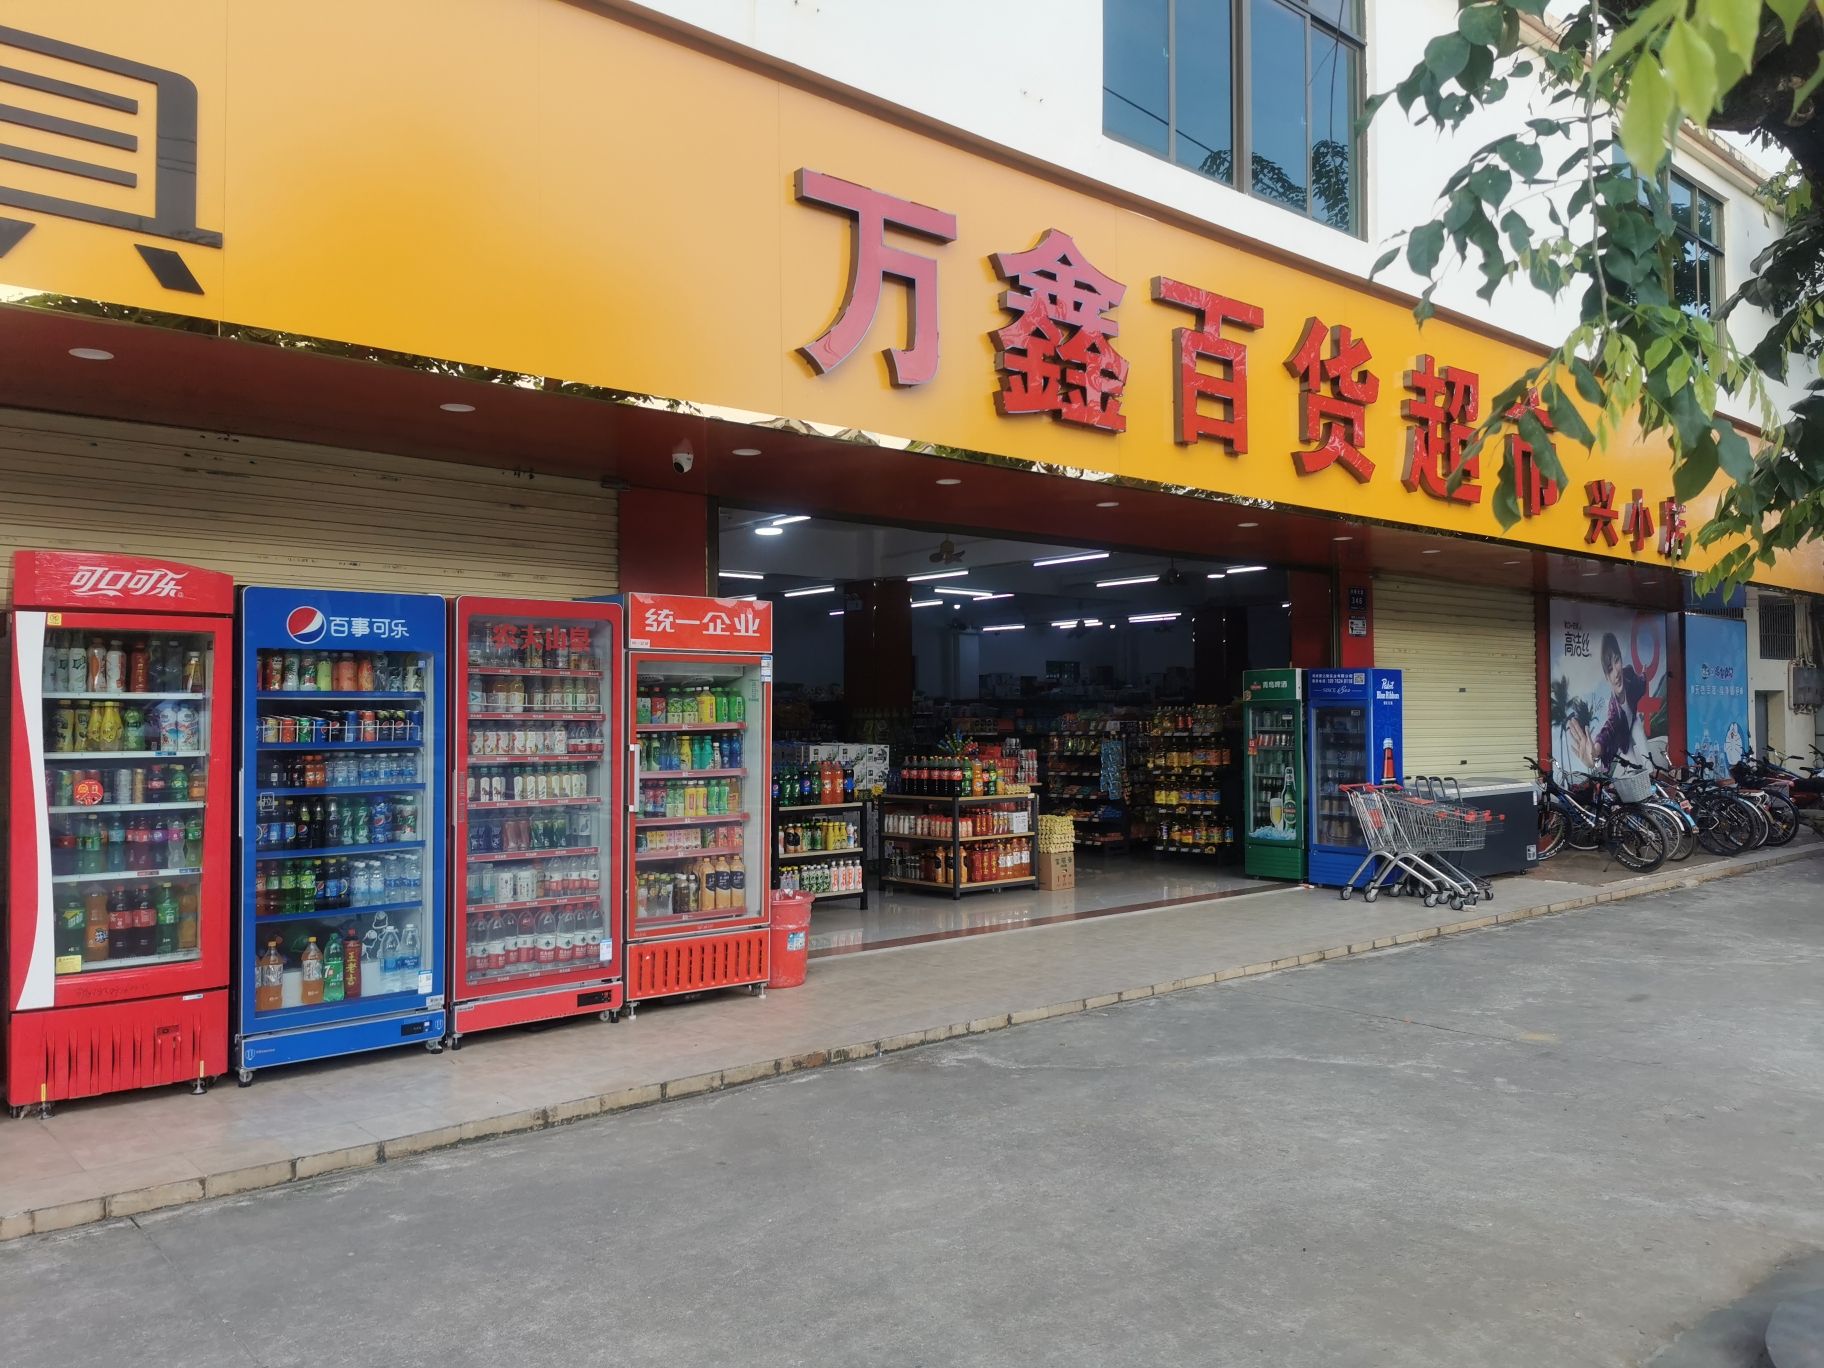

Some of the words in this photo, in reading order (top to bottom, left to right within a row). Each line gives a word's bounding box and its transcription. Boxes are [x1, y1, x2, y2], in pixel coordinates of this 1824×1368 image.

[795, 167, 1560, 520] 万鑫百货超市
[70, 565, 189, 598] 可口可乐
[329, 616, 410, 638] 百事可乐
[645, 607, 760, 637] 统一企业
[492, 622, 591, 653] 农夫山泉
[1564, 631, 1591, 658] 高洁丝
